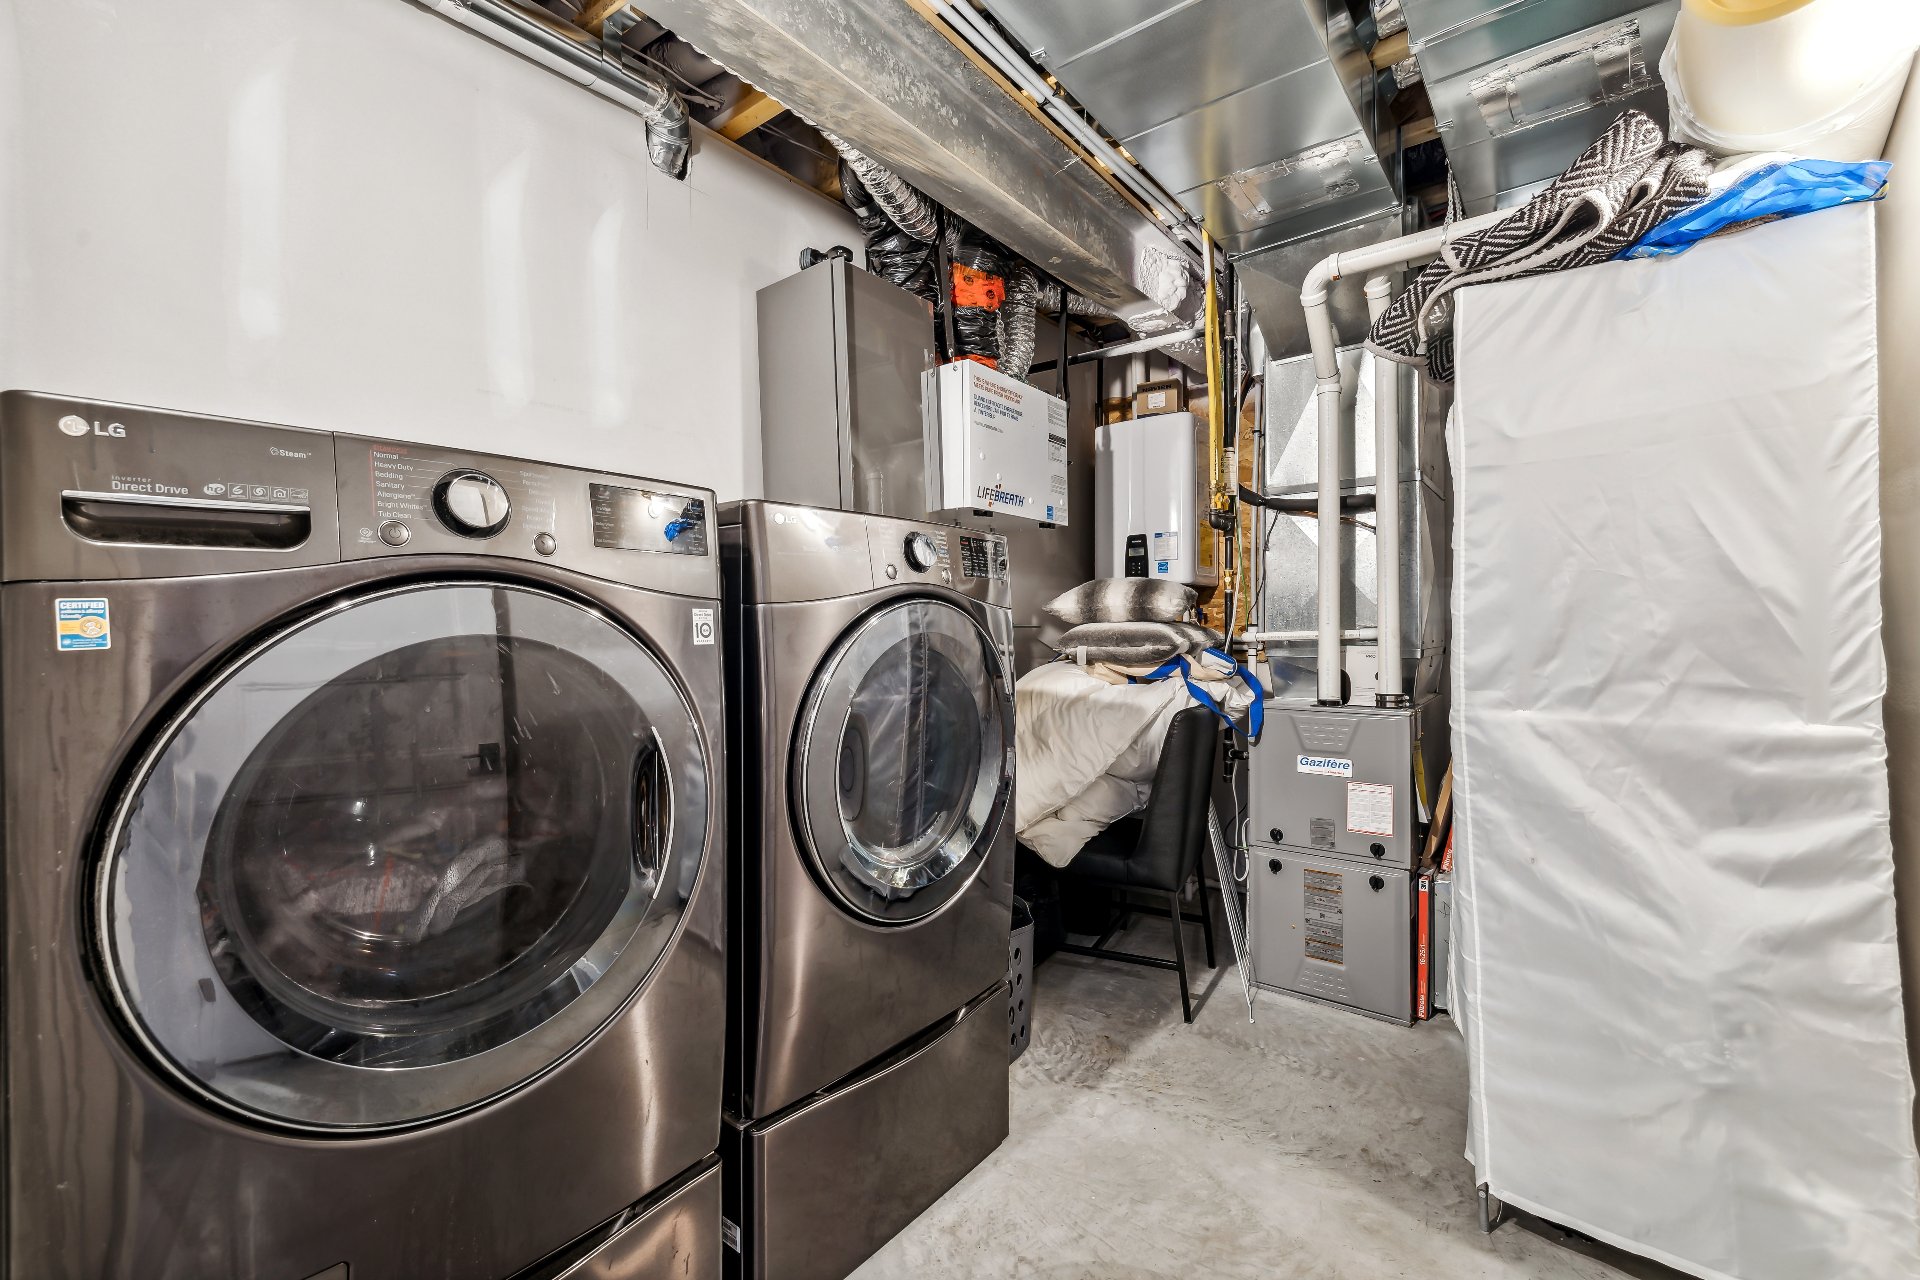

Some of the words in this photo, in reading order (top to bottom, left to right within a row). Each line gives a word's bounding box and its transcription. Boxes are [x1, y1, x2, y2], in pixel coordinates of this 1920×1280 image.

[94, 421, 126, 437] LG
[373, 451, 399, 459] Normal
[374, 461, 396, 470] Heavy
[397, 463, 414, 471] Duty
[375, 471, 403, 480] Bedding
[111, 480, 153, 493] Direct
[155, 483, 190, 496] Drive
[376, 481, 404, 490] Sanitary
[976, 485, 1025, 508] LIFEBREATH
[377, 501, 398, 510] Bright
[60, 601, 104, 609] CERTIFIED
[695, 622, 711, 638] 10
[1299, 756, 1351, 770] Gazifère
[1420, 881, 1427, 891] 3M
